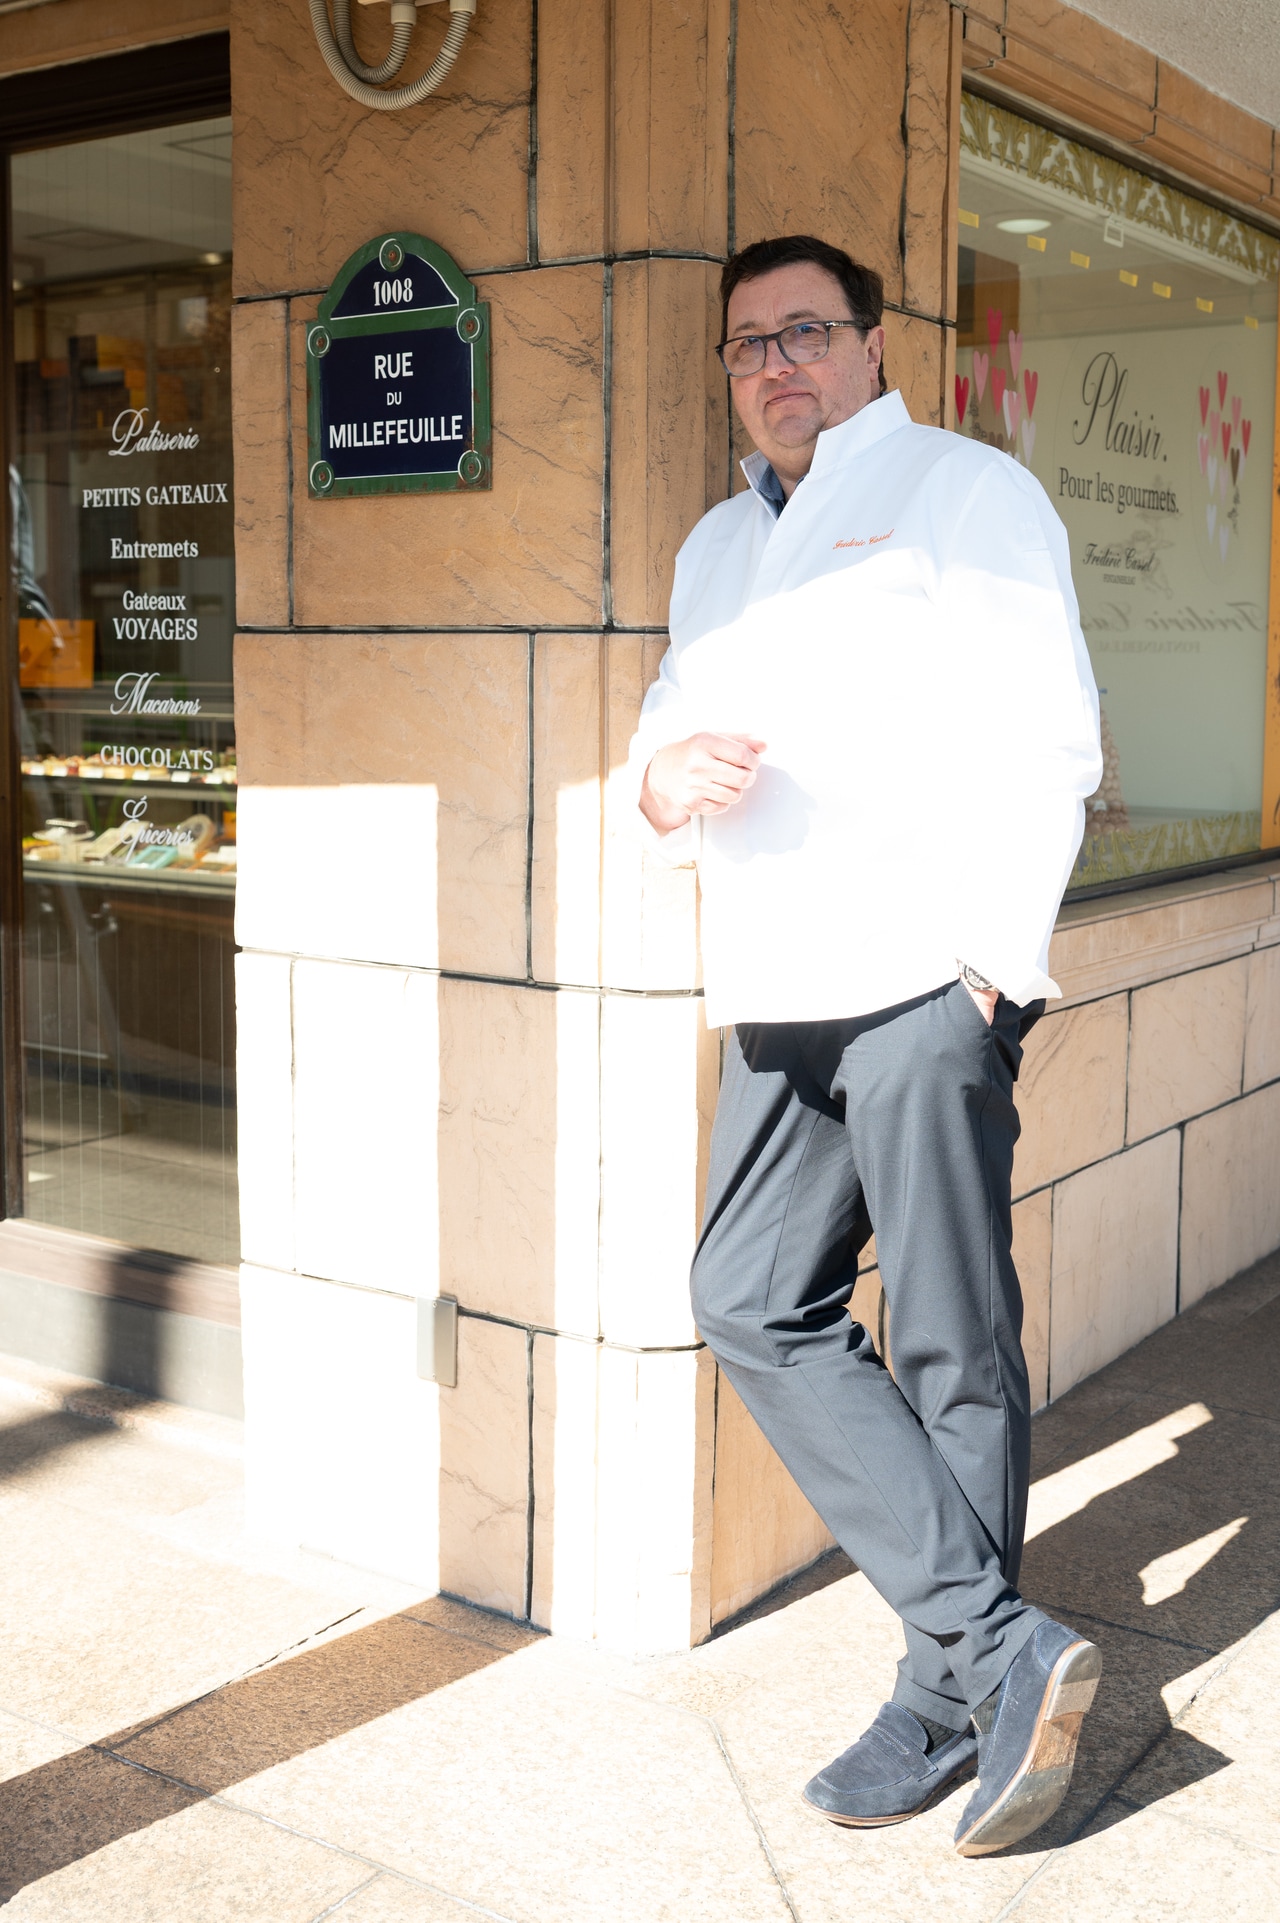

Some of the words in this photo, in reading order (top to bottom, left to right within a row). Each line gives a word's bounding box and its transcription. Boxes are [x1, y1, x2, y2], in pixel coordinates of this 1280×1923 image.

[373, 278, 413, 306] 1008
[374, 352, 414, 379] RUE
[386, 392, 402, 406] DU
[1072, 351, 1167, 462] Plaisir.
[108, 407, 200, 456] Patisserie
[329, 415, 463, 449] MILLEFEUILLE
[82, 487, 141, 508] PETITS
[145, 483, 228, 505] GATEAUX
[1059, 467, 1093, 501] Pour
[1096, 471, 1115, 504] les
[1117, 484, 1180, 514] gourmets.
[110, 538, 199, 559] Entremets
[122, 590, 187, 611] Gateaux
[113, 617, 198, 640] VOYAGES
[110, 672, 201, 715] Macarons
[100, 745, 214, 771] CHOCOLATS
